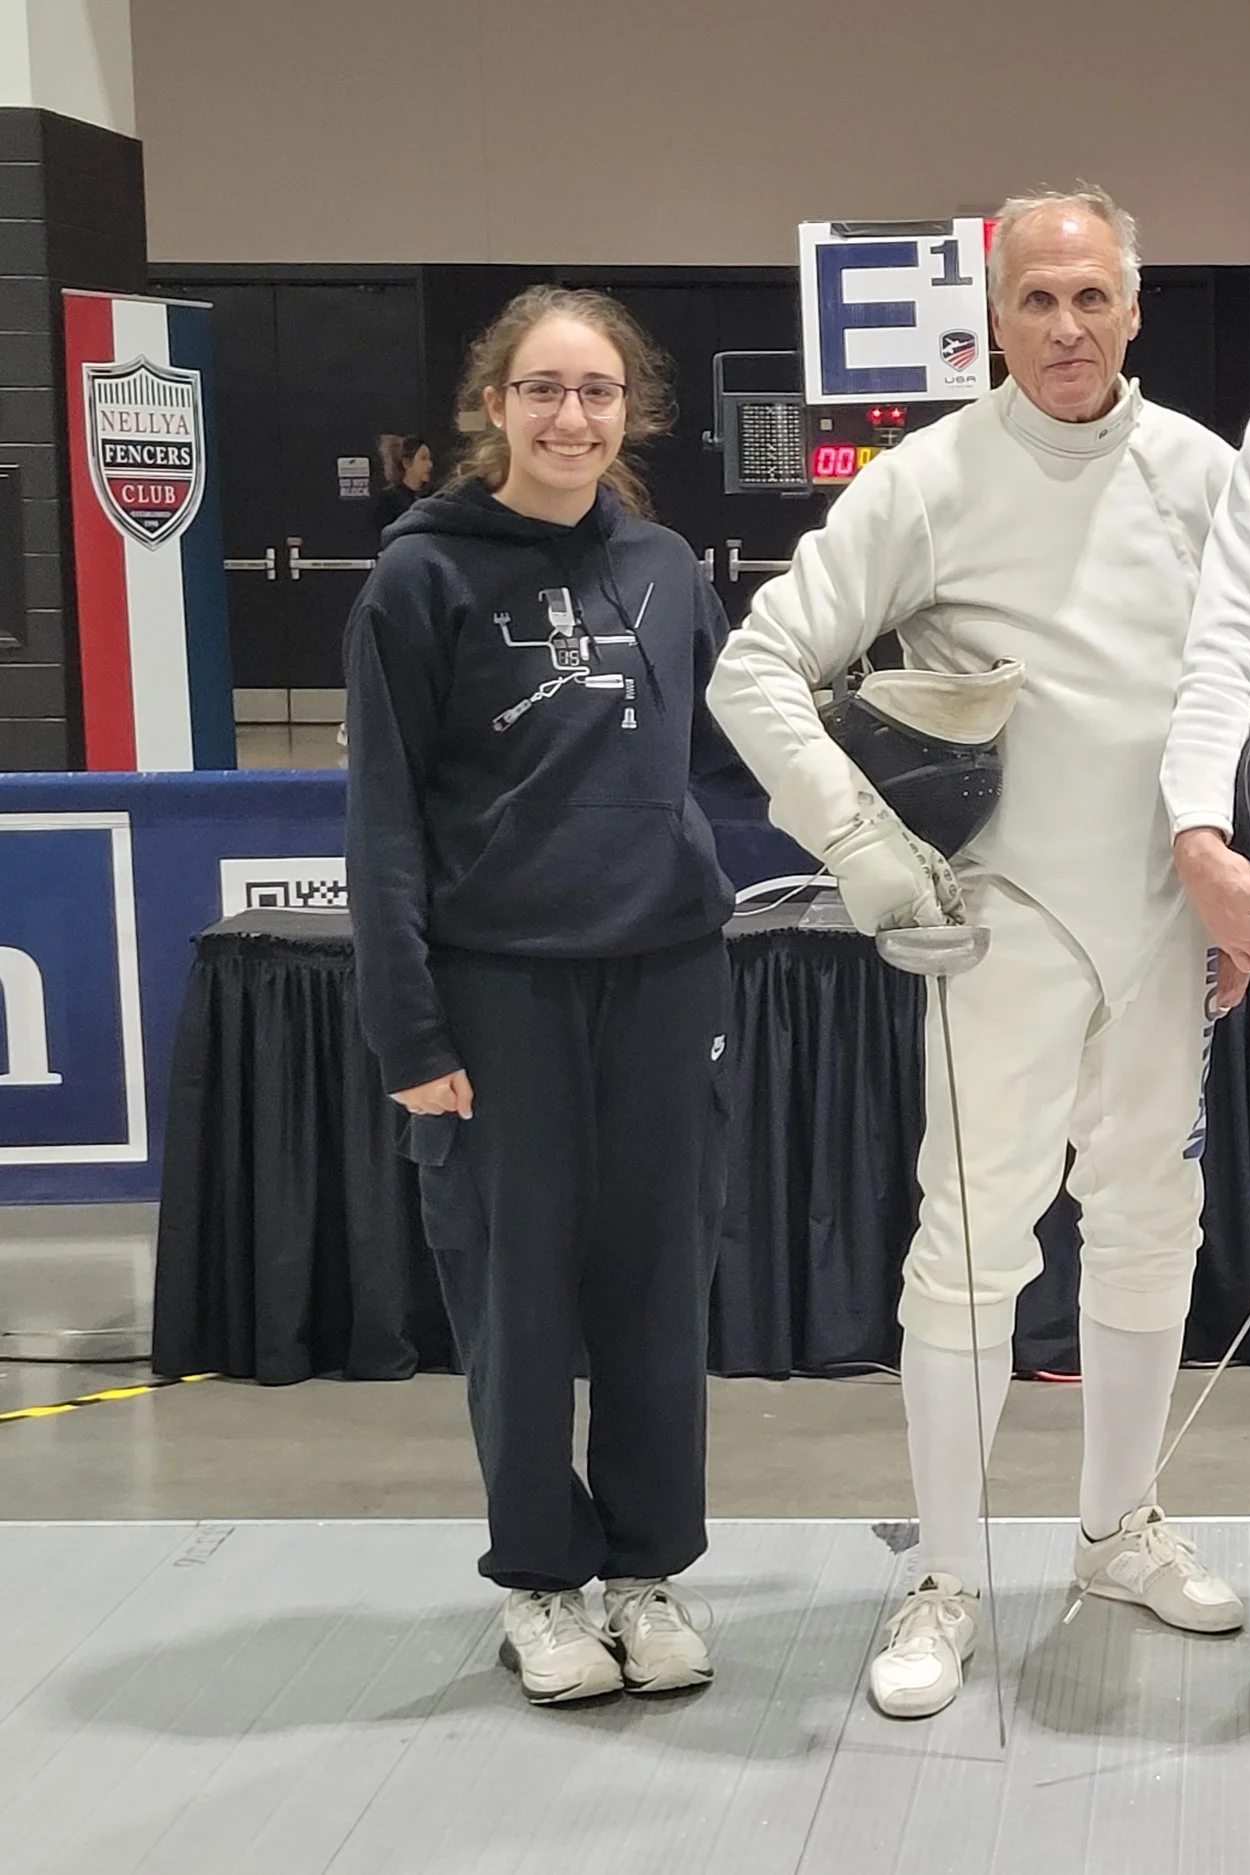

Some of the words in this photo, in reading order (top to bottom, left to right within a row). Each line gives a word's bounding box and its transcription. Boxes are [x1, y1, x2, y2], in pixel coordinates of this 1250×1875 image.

[101, 410, 190, 435] NELLYA
[105, 444, 191, 465] FENCERS
[817, 447, 855, 474] 00
[122, 485, 176, 504] CLUB
